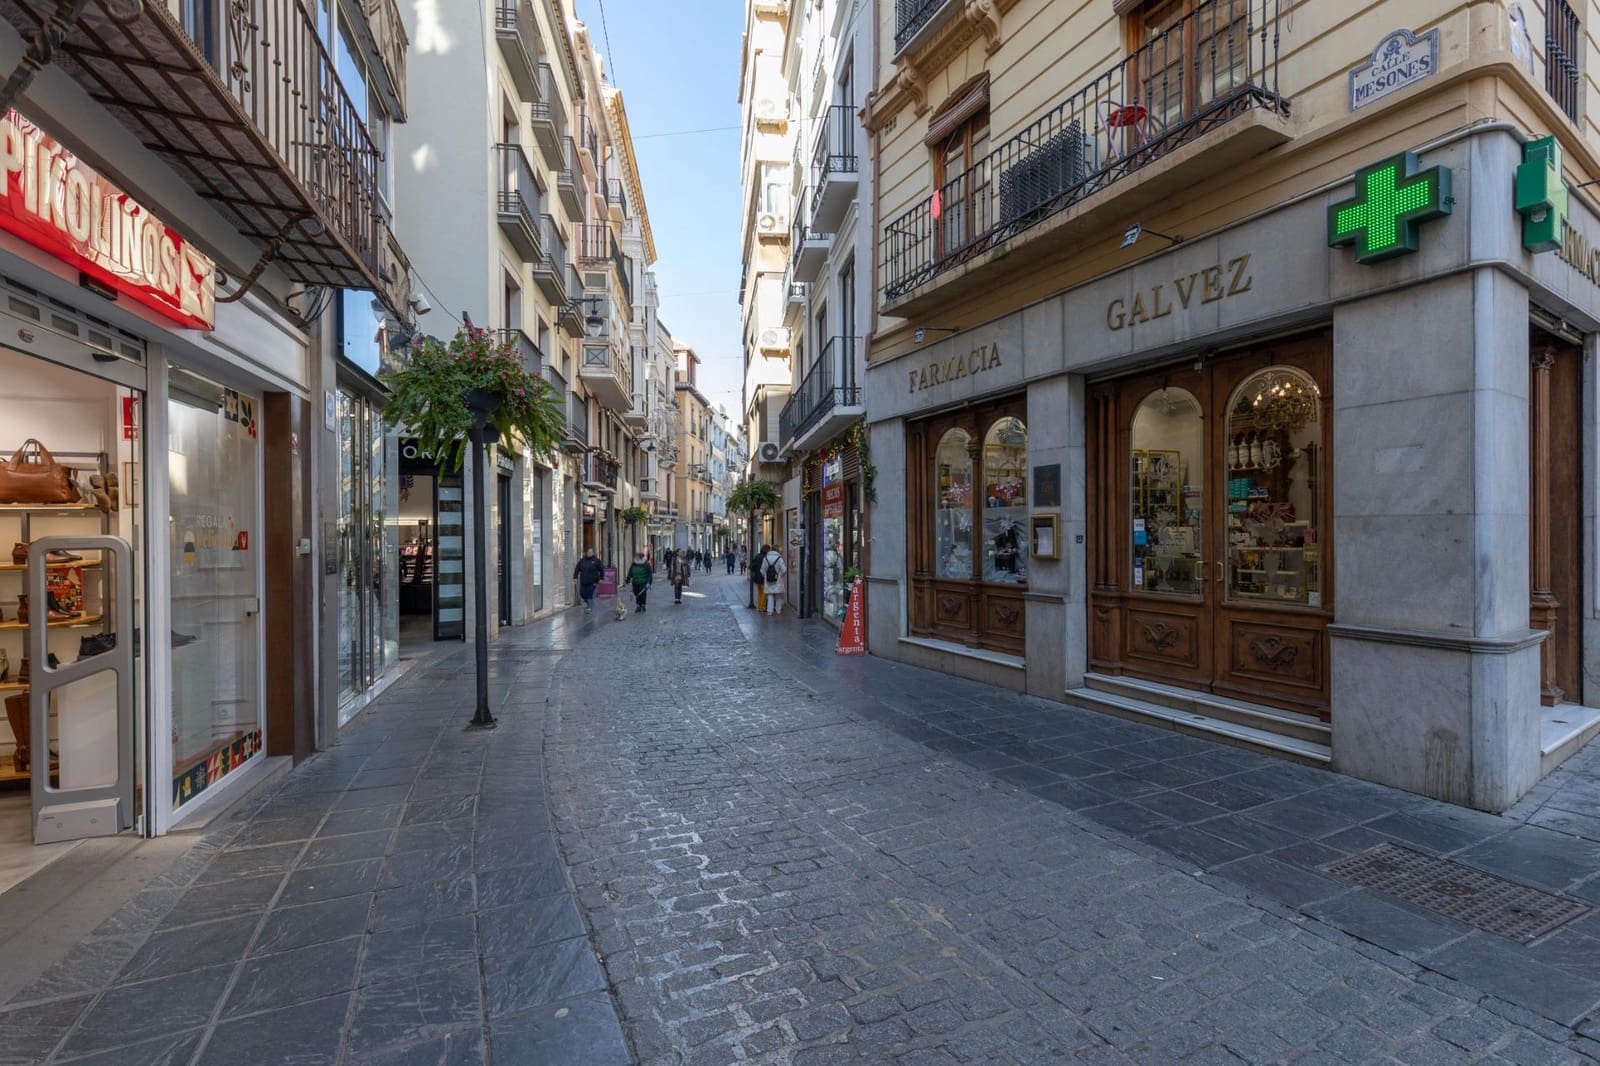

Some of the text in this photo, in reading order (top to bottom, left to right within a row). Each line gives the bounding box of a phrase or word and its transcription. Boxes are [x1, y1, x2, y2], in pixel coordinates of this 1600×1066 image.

[1355, 55, 1430, 102] MESONES
[1371, 51, 1410, 77] CALLE
[0, 118, 178, 299] PIKOLINOS
[908, 254, 1252, 394] FARMACIA GALVEZ
[838, 645, 864, 654] argenta
